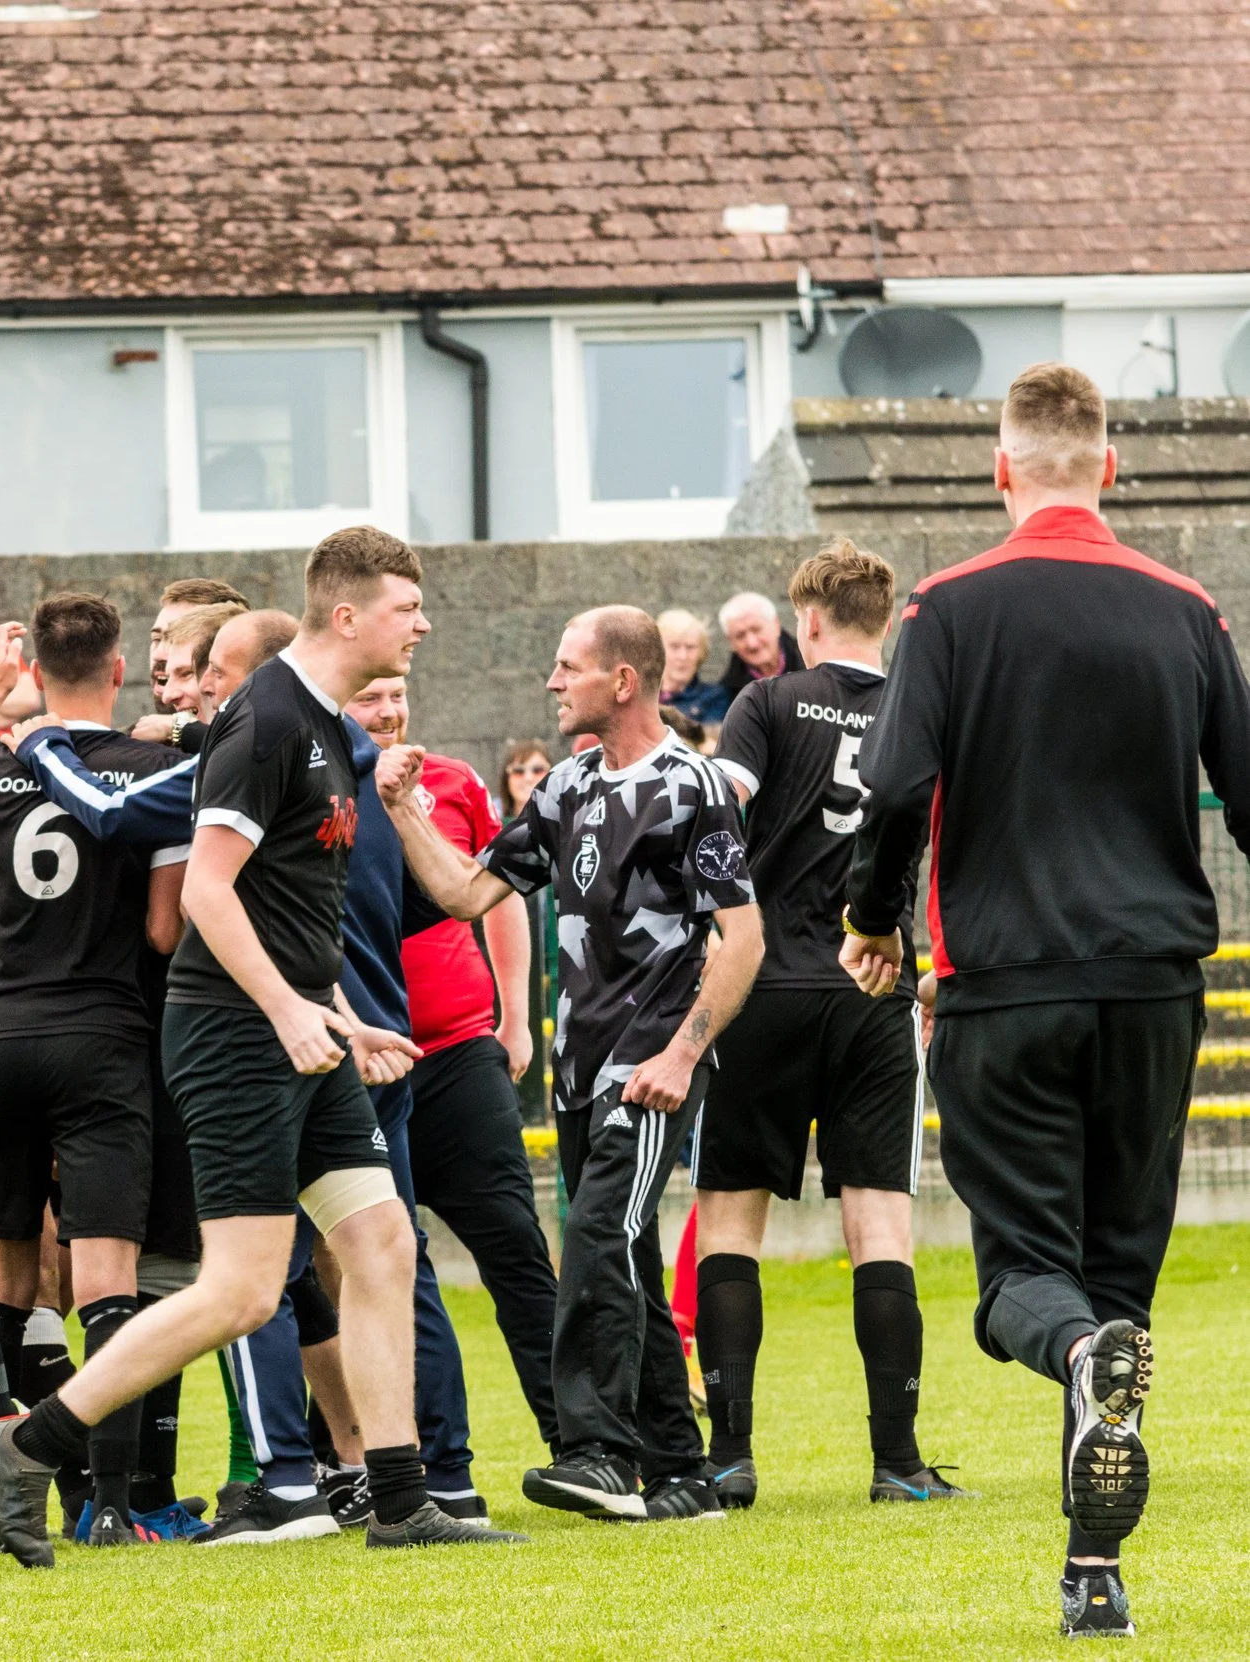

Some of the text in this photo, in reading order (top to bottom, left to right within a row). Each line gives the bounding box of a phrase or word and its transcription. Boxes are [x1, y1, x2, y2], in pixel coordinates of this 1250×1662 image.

[91, 770, 135, 788] OW
[822, 731, 872, 834] 5
[13, 801, 79, 900] 6
